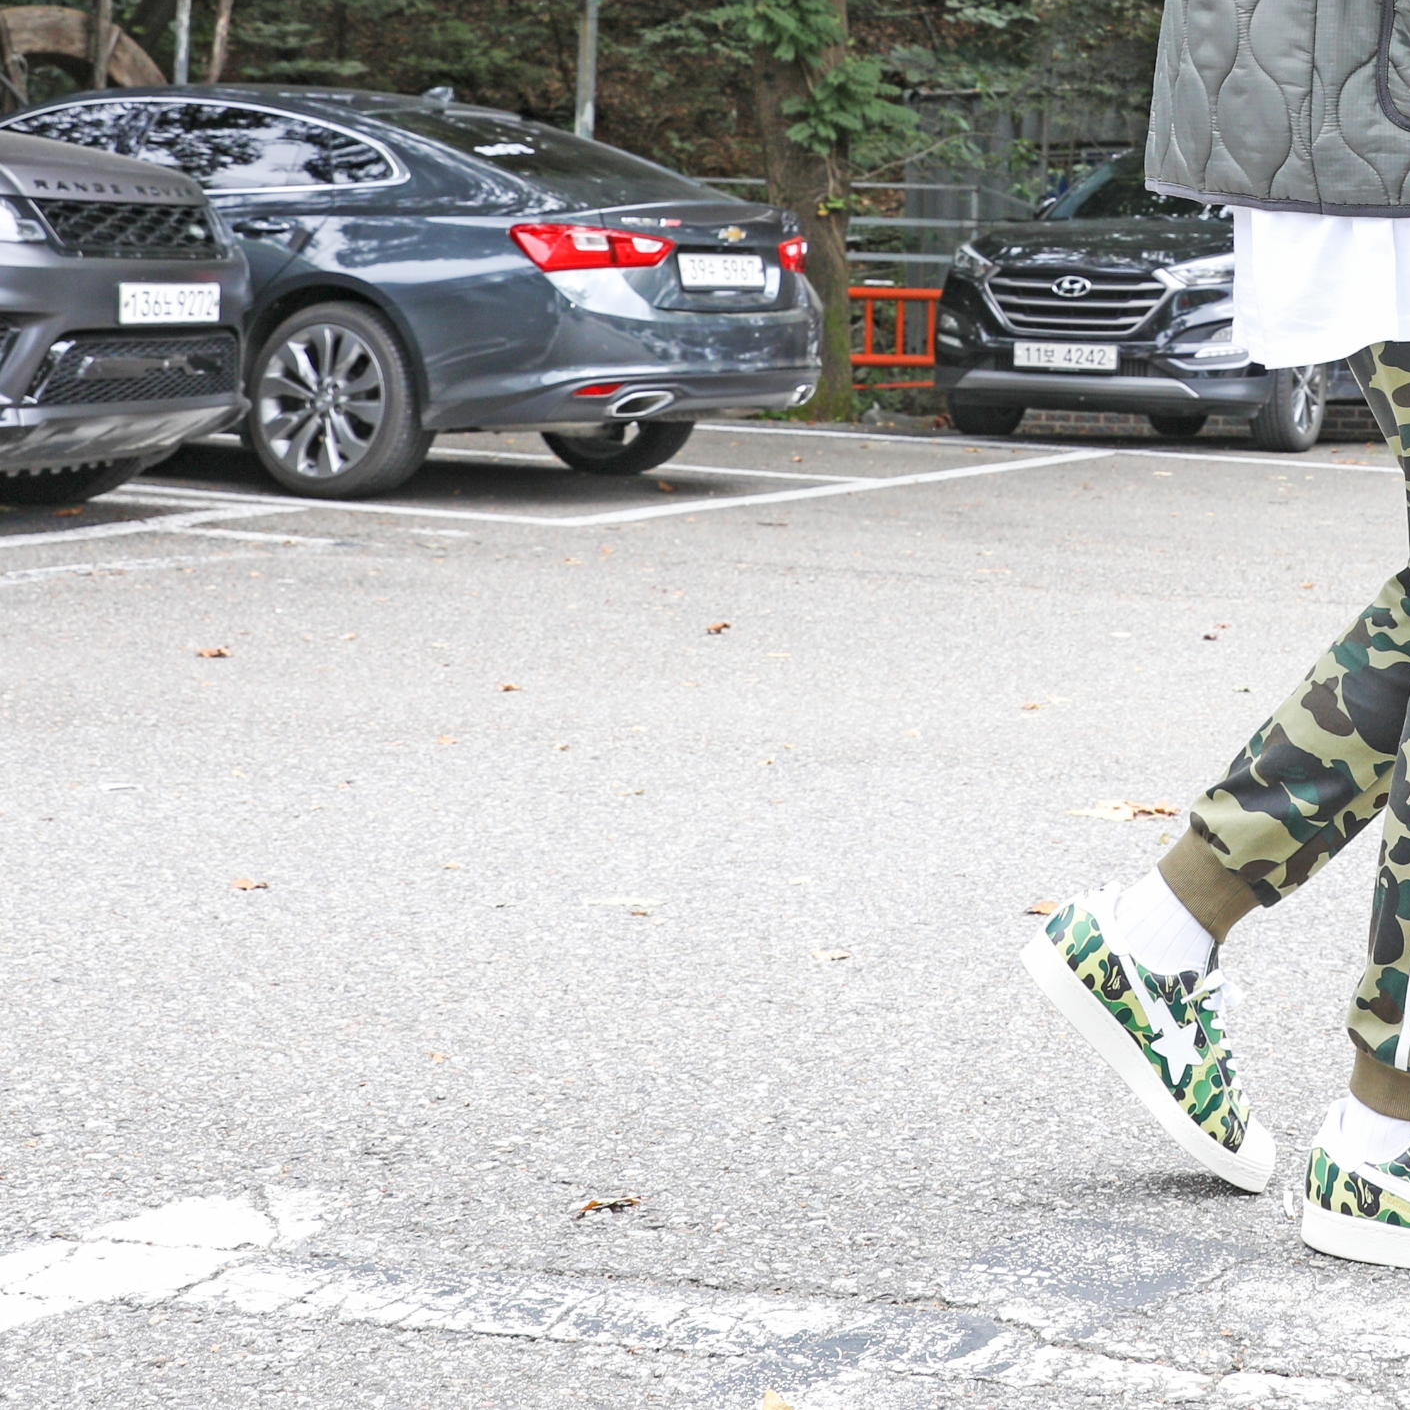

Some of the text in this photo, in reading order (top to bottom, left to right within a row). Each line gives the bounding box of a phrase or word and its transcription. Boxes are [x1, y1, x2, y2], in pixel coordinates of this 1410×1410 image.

[34, 179, 196, 198] RANGE ROVER
[178, 290, 215, 317] 9272
[1063, 347, 1107, 366] 4242
